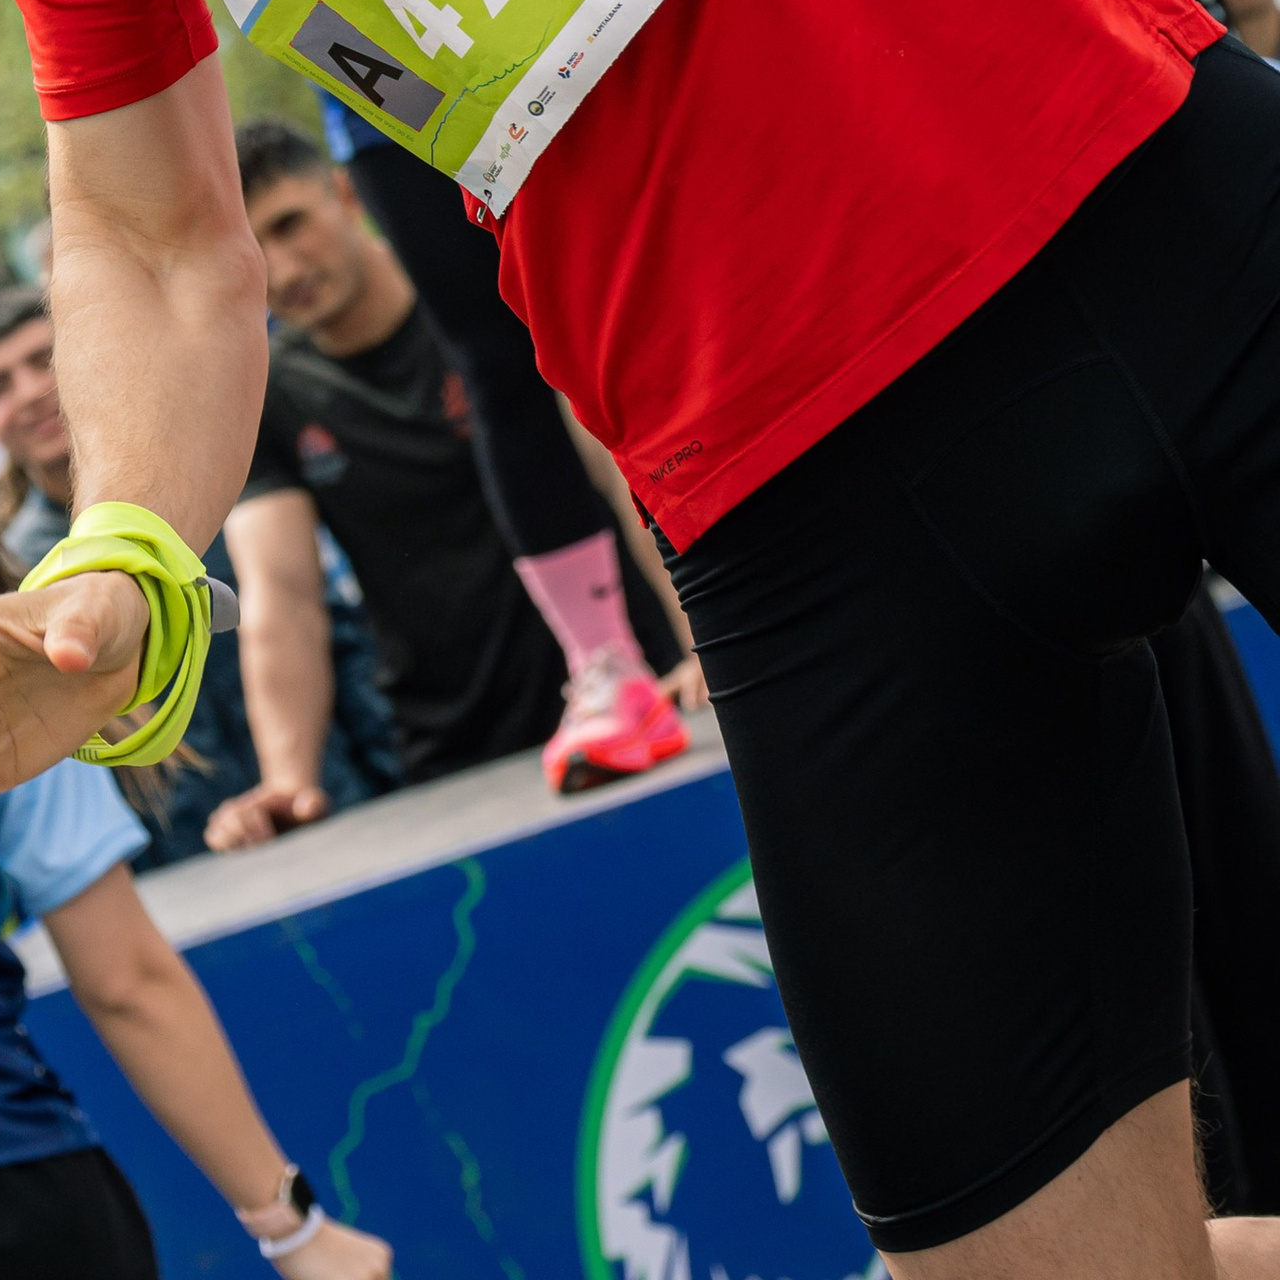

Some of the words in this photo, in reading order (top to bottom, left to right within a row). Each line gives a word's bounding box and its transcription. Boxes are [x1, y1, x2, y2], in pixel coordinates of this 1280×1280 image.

[591, 1, 623, 38] KAPITALBANK
[327, 41, 404, 106] A
[570, 50, 586, 69] GROUP
[648, 457, 676, 484] NIKE
[673, 439, 703, 466] PRO
